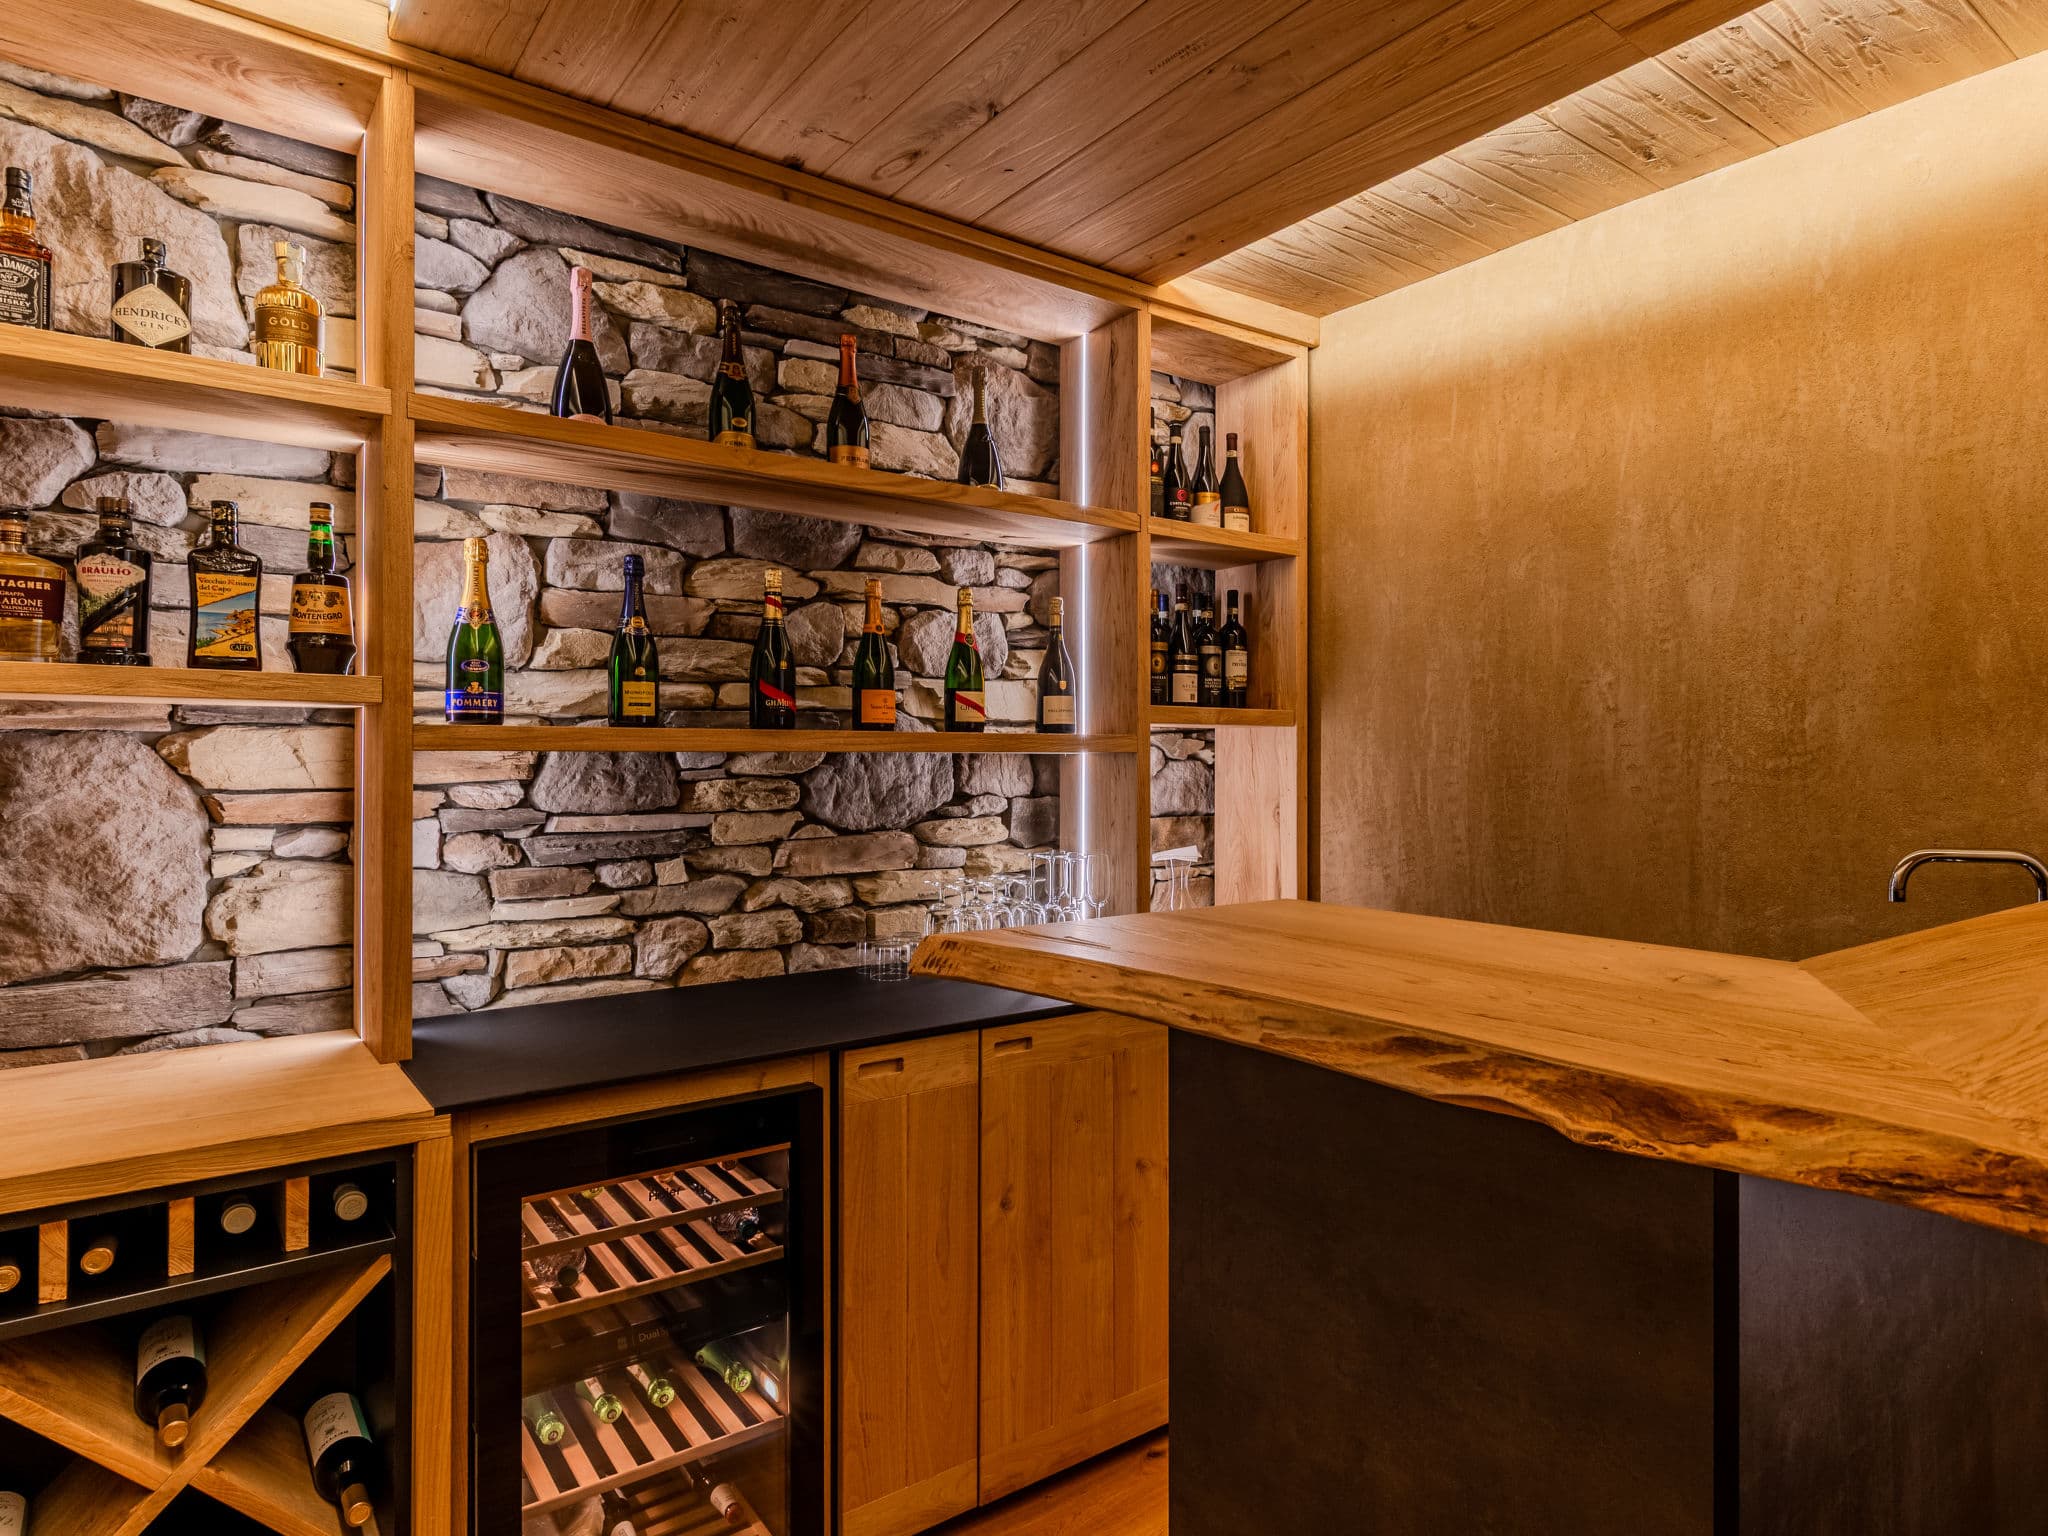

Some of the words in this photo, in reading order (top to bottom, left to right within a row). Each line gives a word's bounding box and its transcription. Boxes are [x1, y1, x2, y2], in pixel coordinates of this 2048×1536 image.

[2, 257, 40, 280] DANIEL'S
[115, 307, 188, 329] HENDRICK'S
[268, 316, 310, 331] GOLD
[140, 320, 164, 330] GIN
[81, 566, 132, 576] BRAULIO
[211, 584, 232, 593] Capo
[292, 608, 343, 620] MONTENEGRO
[452, 698, 498, 708] POMMERY
[638, 1328, 661, 1343] Dual
